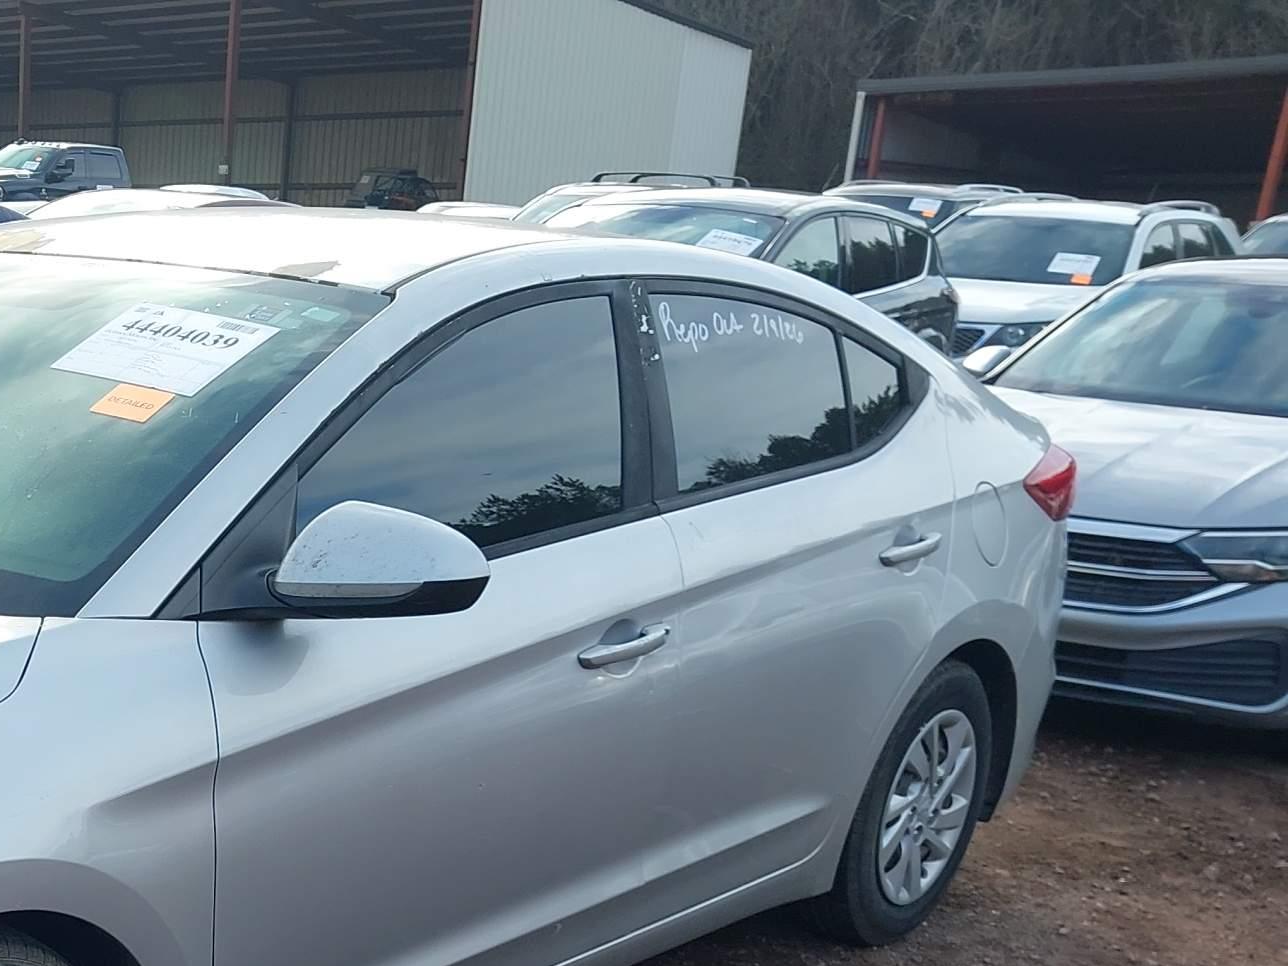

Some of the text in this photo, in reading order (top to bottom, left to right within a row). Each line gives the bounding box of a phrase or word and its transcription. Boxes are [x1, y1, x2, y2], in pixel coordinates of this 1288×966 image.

[121, 319, 240, 350] 44404039
[658, 301, 710, 353] Repo
[107, 394, 155, 411] DETAILED
